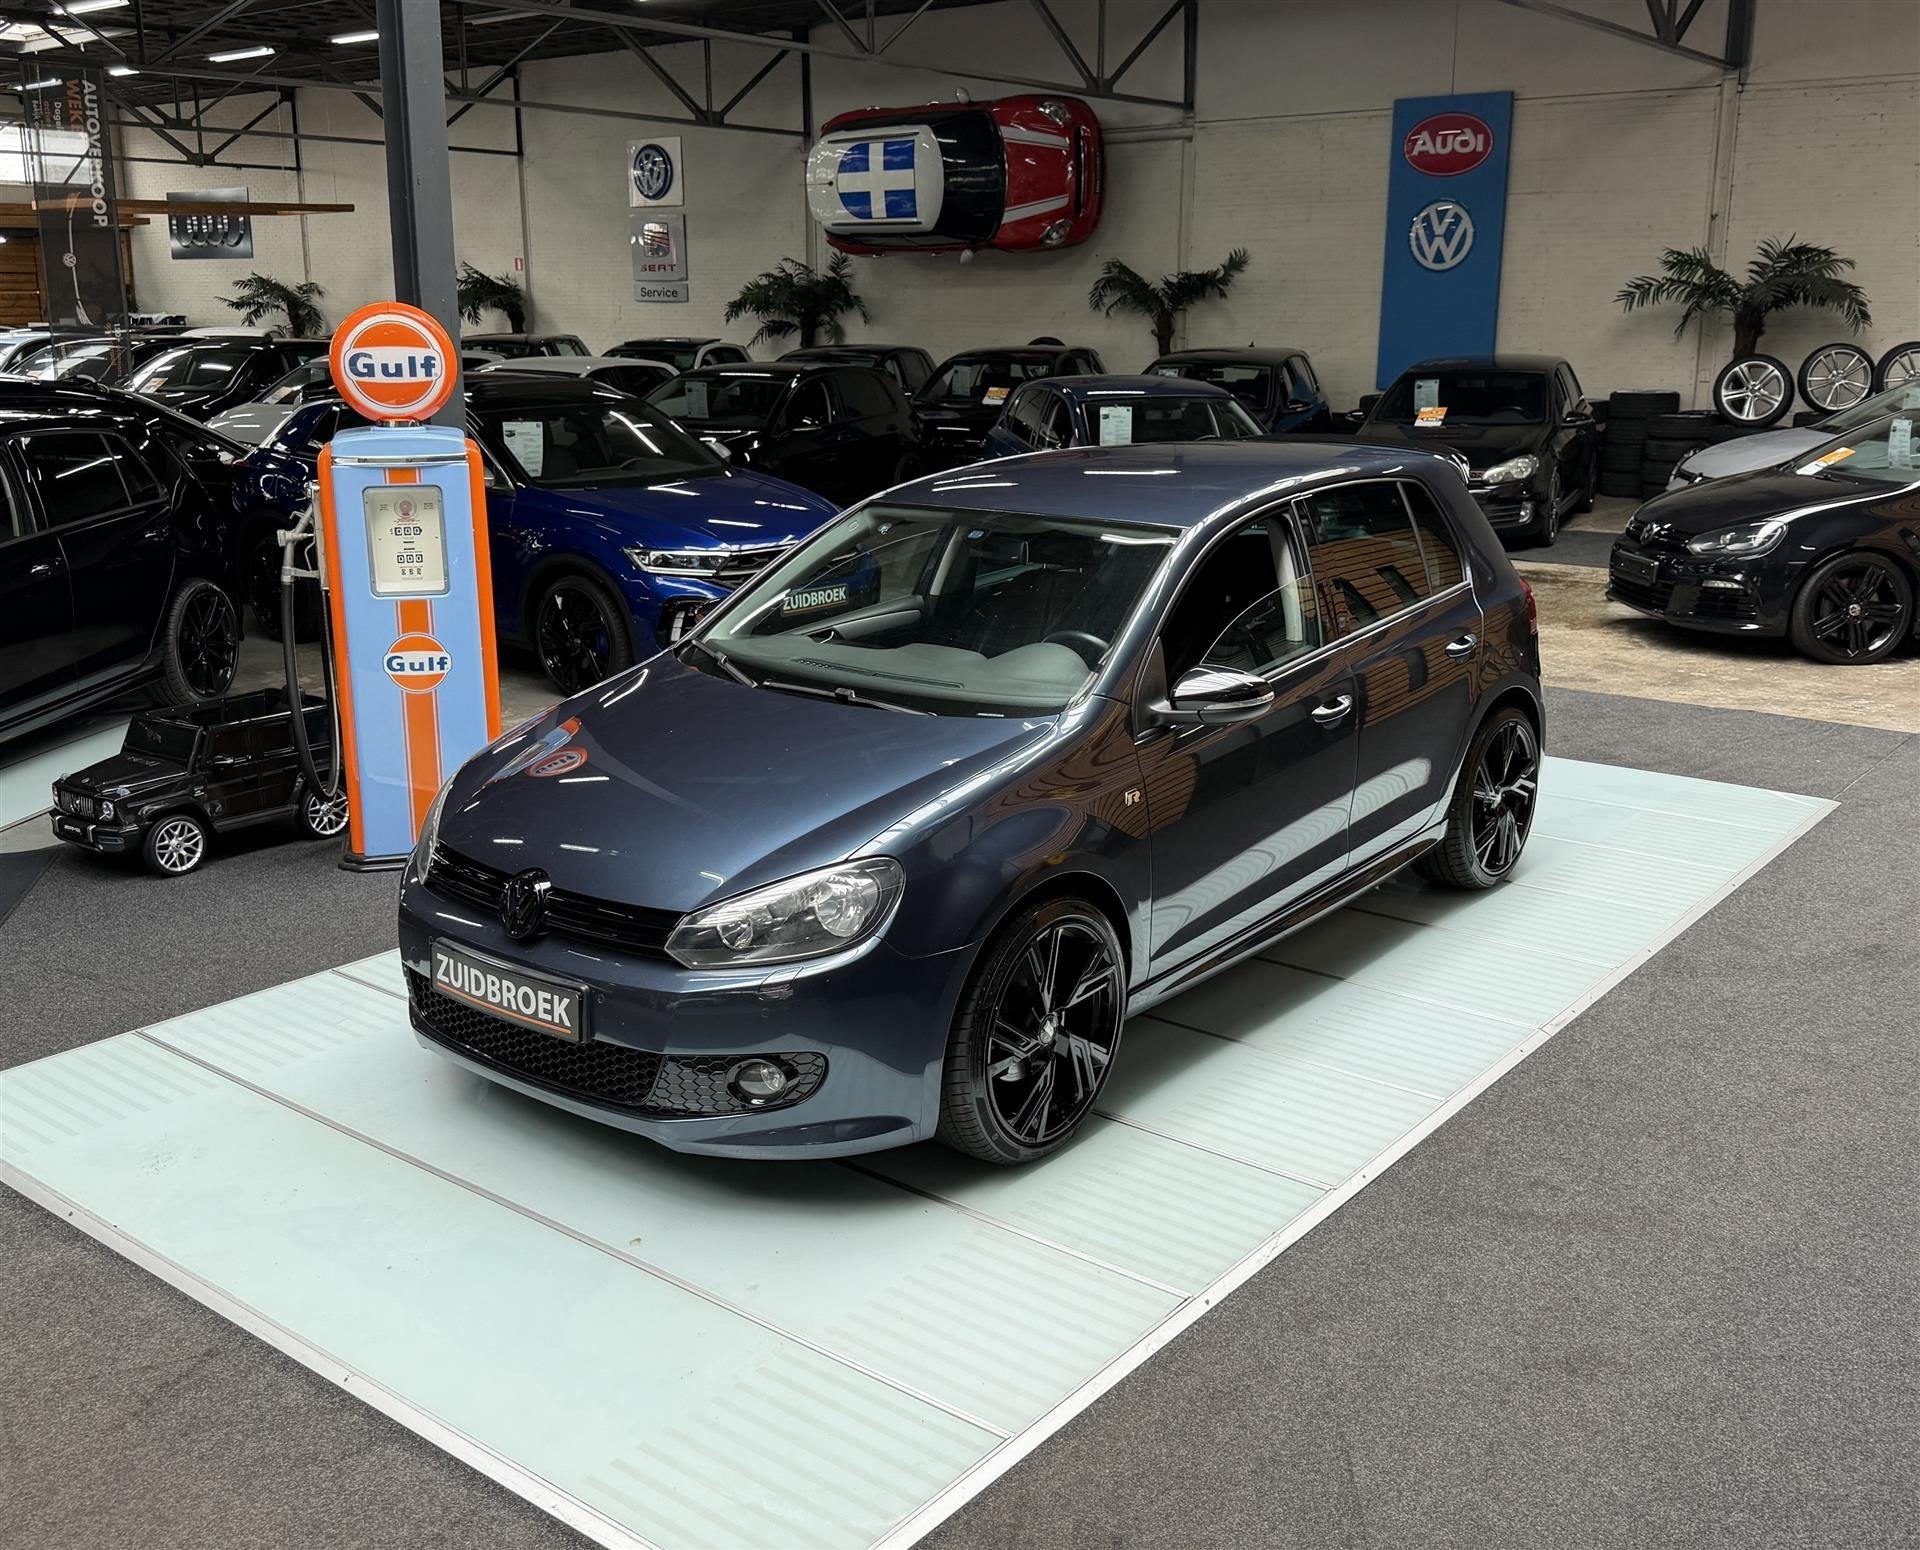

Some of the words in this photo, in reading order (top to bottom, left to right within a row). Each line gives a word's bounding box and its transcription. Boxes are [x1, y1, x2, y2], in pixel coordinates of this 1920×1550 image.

[82, 79, 108, 227] AUTOVERKOOP
[640, 264, 677, 272] SEAT
[640, 286, 678, 298] Service
[348, 352, 436, 378] Gulf
[783, 586, 847, 610] ZUIDBROEK
[386, 655, 448, 672] Gulf
[436, 953, 572, 1027] ZUIDBROEK
